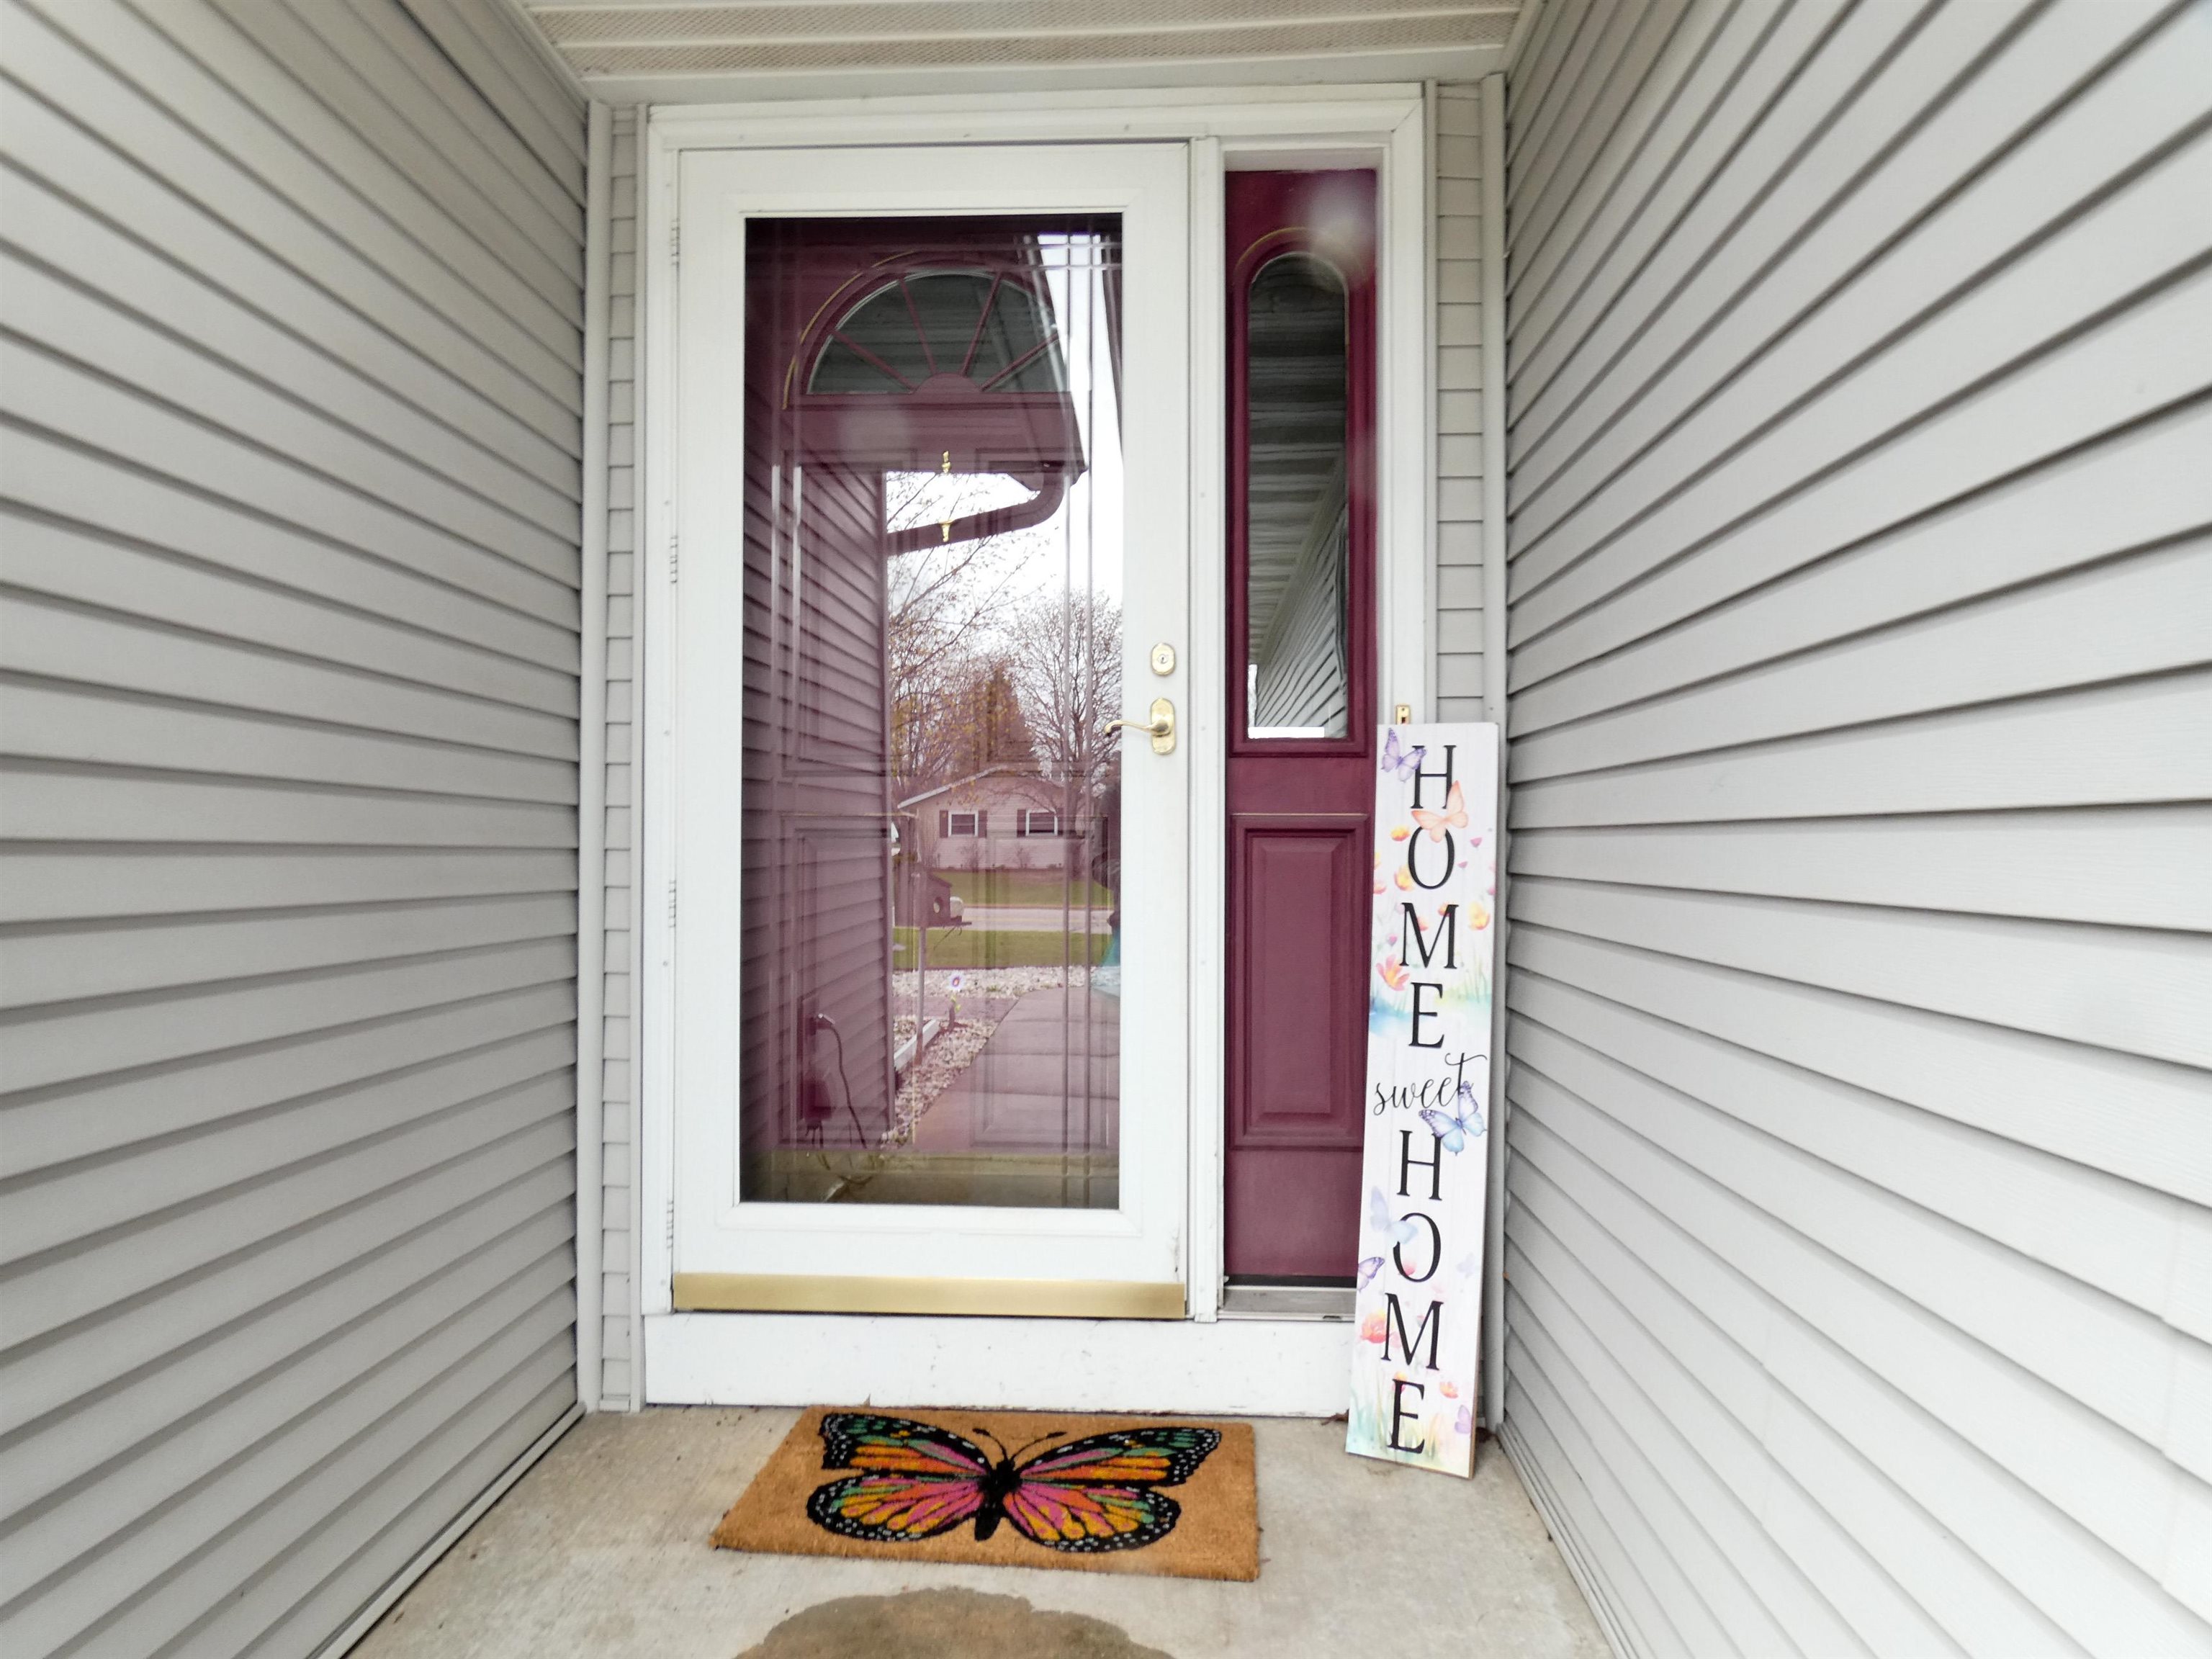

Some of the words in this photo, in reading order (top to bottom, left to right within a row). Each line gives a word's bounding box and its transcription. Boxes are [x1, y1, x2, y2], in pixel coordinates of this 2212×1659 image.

[1399, 745, 1459, 1049] HOME
[1373, 1053, 1488, 1115] sweet
[1380, 1130, 1444, 1454] HOME
